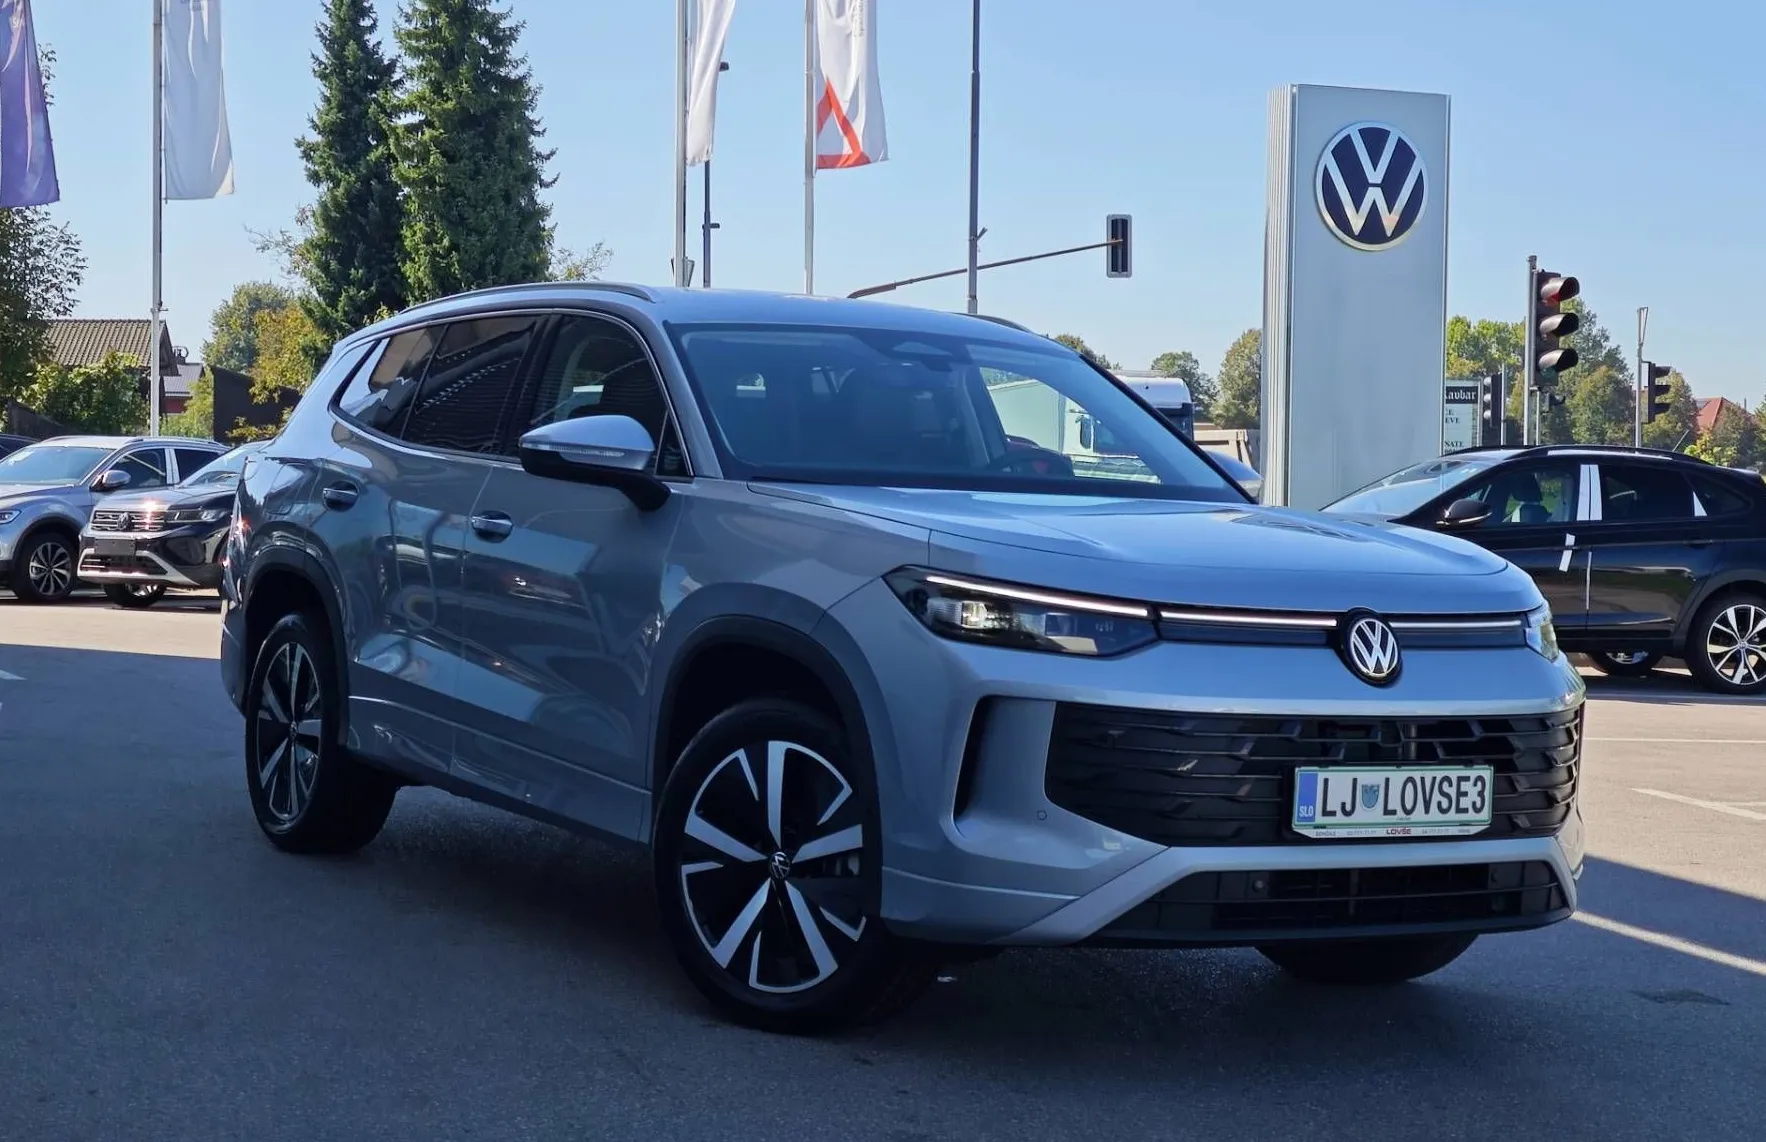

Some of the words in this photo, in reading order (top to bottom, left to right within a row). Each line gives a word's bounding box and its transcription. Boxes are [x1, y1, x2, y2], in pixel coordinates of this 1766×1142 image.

[1317, 124, 1427, 246] VW
[1350, 618, 1398, 677] VW
[1298, 807, 1314, 818] SLO
[1321, 777, 1358, 818] LJ
[1382, 775, 1487, 816] LOVSE3
